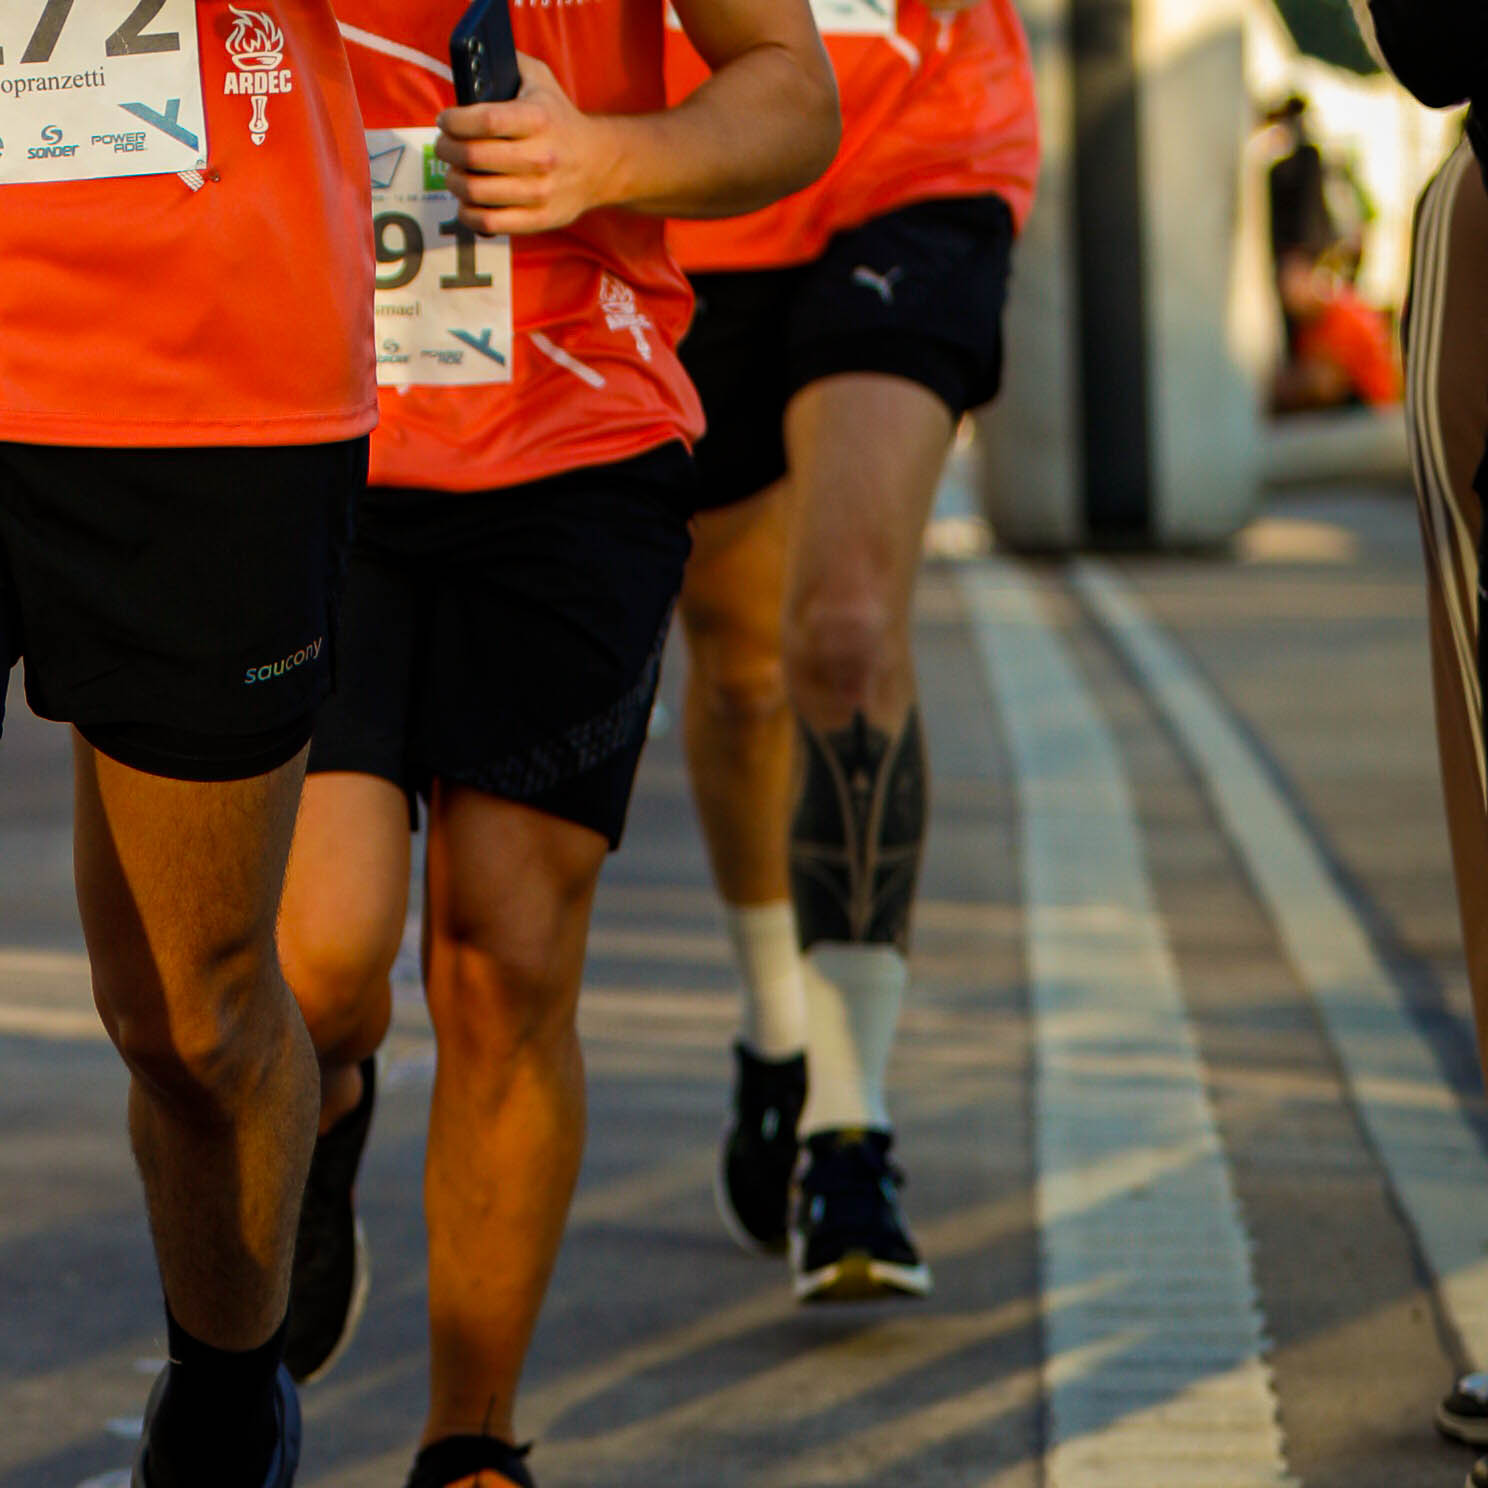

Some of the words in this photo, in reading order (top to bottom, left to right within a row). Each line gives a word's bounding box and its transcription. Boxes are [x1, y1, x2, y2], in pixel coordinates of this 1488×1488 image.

[224, 70, 292, 94] ARDEC
[91, 132, 146, 146] POWER
[114, 142, 145, 153] ADE
[374, 211, 493, 289] 91
[243, 635, 323, 684] saucony
